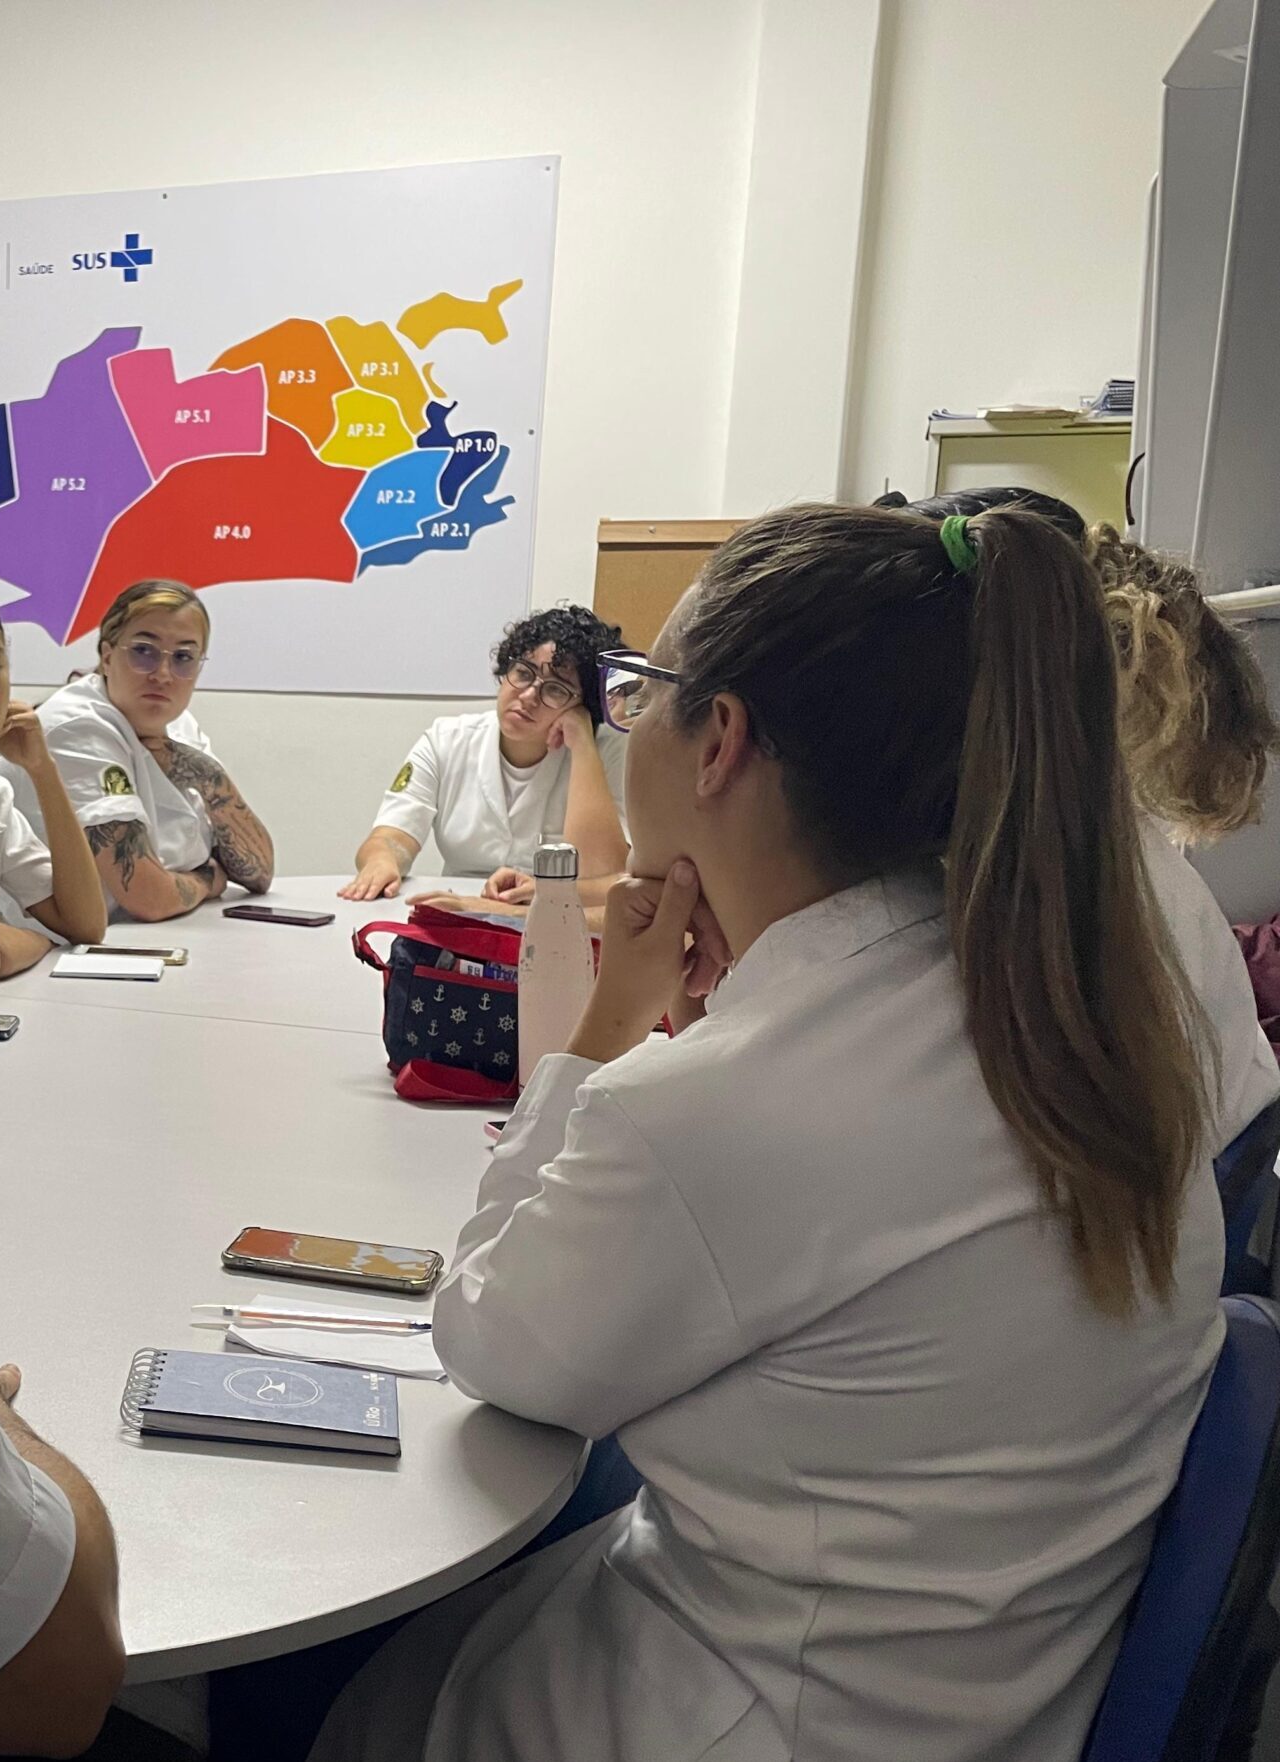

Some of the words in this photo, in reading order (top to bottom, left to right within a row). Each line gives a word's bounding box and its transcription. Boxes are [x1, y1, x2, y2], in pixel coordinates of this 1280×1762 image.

[72, 252, 107, 271] SUS
[18, 263, 54, 276] SAÚDE
[278, 370, 296, 384] AP
[297, 369, 316, 384] 3.3
[361, 362, 378, 377] AP
[380, 361, 399, 376] 3.1
[174, 409, 191, 424] AP
[192, 409, 211, 423] 5.1
[346, 423, 364, 437] AP
[366, 423, 385, 437] 3.2
[455, 437, 473, 453] AP
[475, 437, 495, 452] 1.0
[51, 478, 67, 491] AP
[68, 478, 86, 491] 5.2
[376, 489, 394, 504] AP
[395, 489, 416, 504] 2.2
[213, 525, 231, 539] AP
[231, 525, 251, 539] 4.0
[430, 522, 449, 537] AP
[450, 522, 470, 537] 2.1
